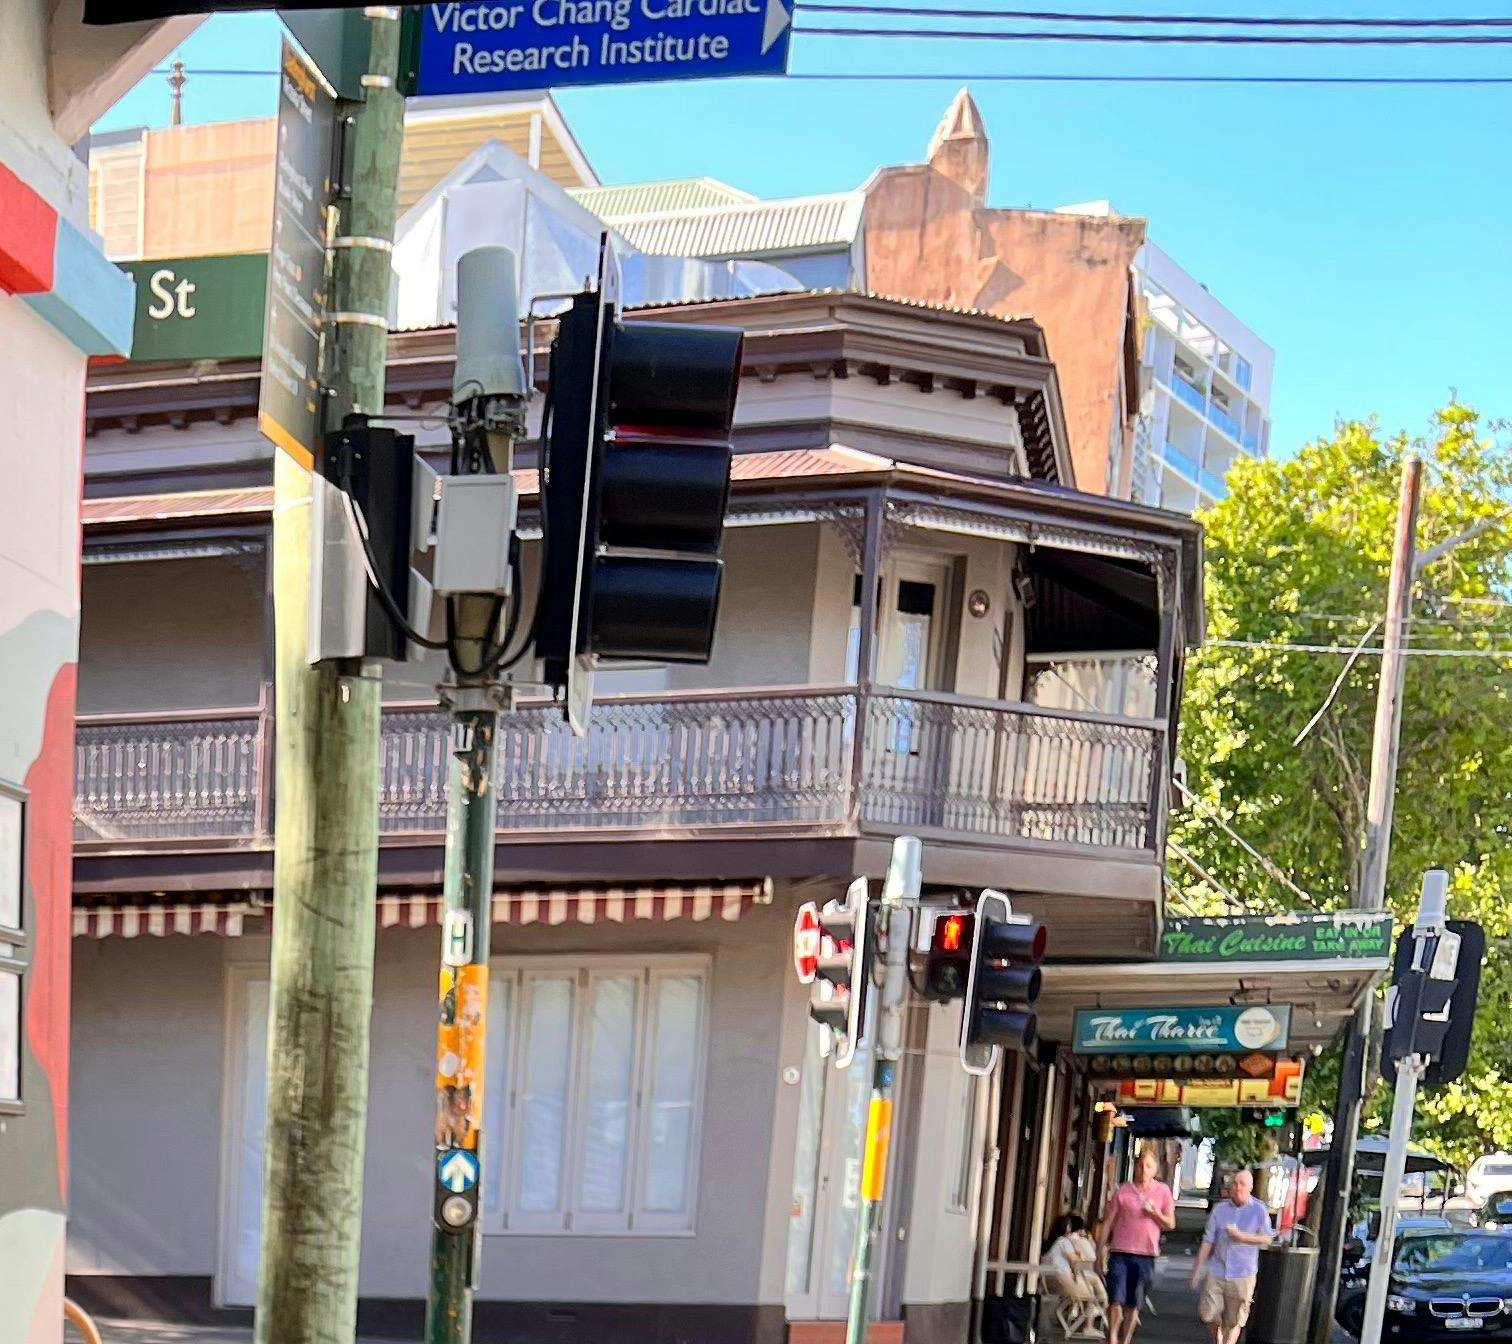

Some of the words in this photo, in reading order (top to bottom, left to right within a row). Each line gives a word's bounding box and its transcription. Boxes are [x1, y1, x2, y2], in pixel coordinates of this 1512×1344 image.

[431, 2, 524, 33] Victor
[532, 0, 631, 31] Chang
[452, 35, 589, 75] Research
[600, 31, 729, 65] Institute
[148, 269, 196, 320] St
[1164, 932, 1216, 954] Thai
[1219, 928, 1306, 957] Cuisine
